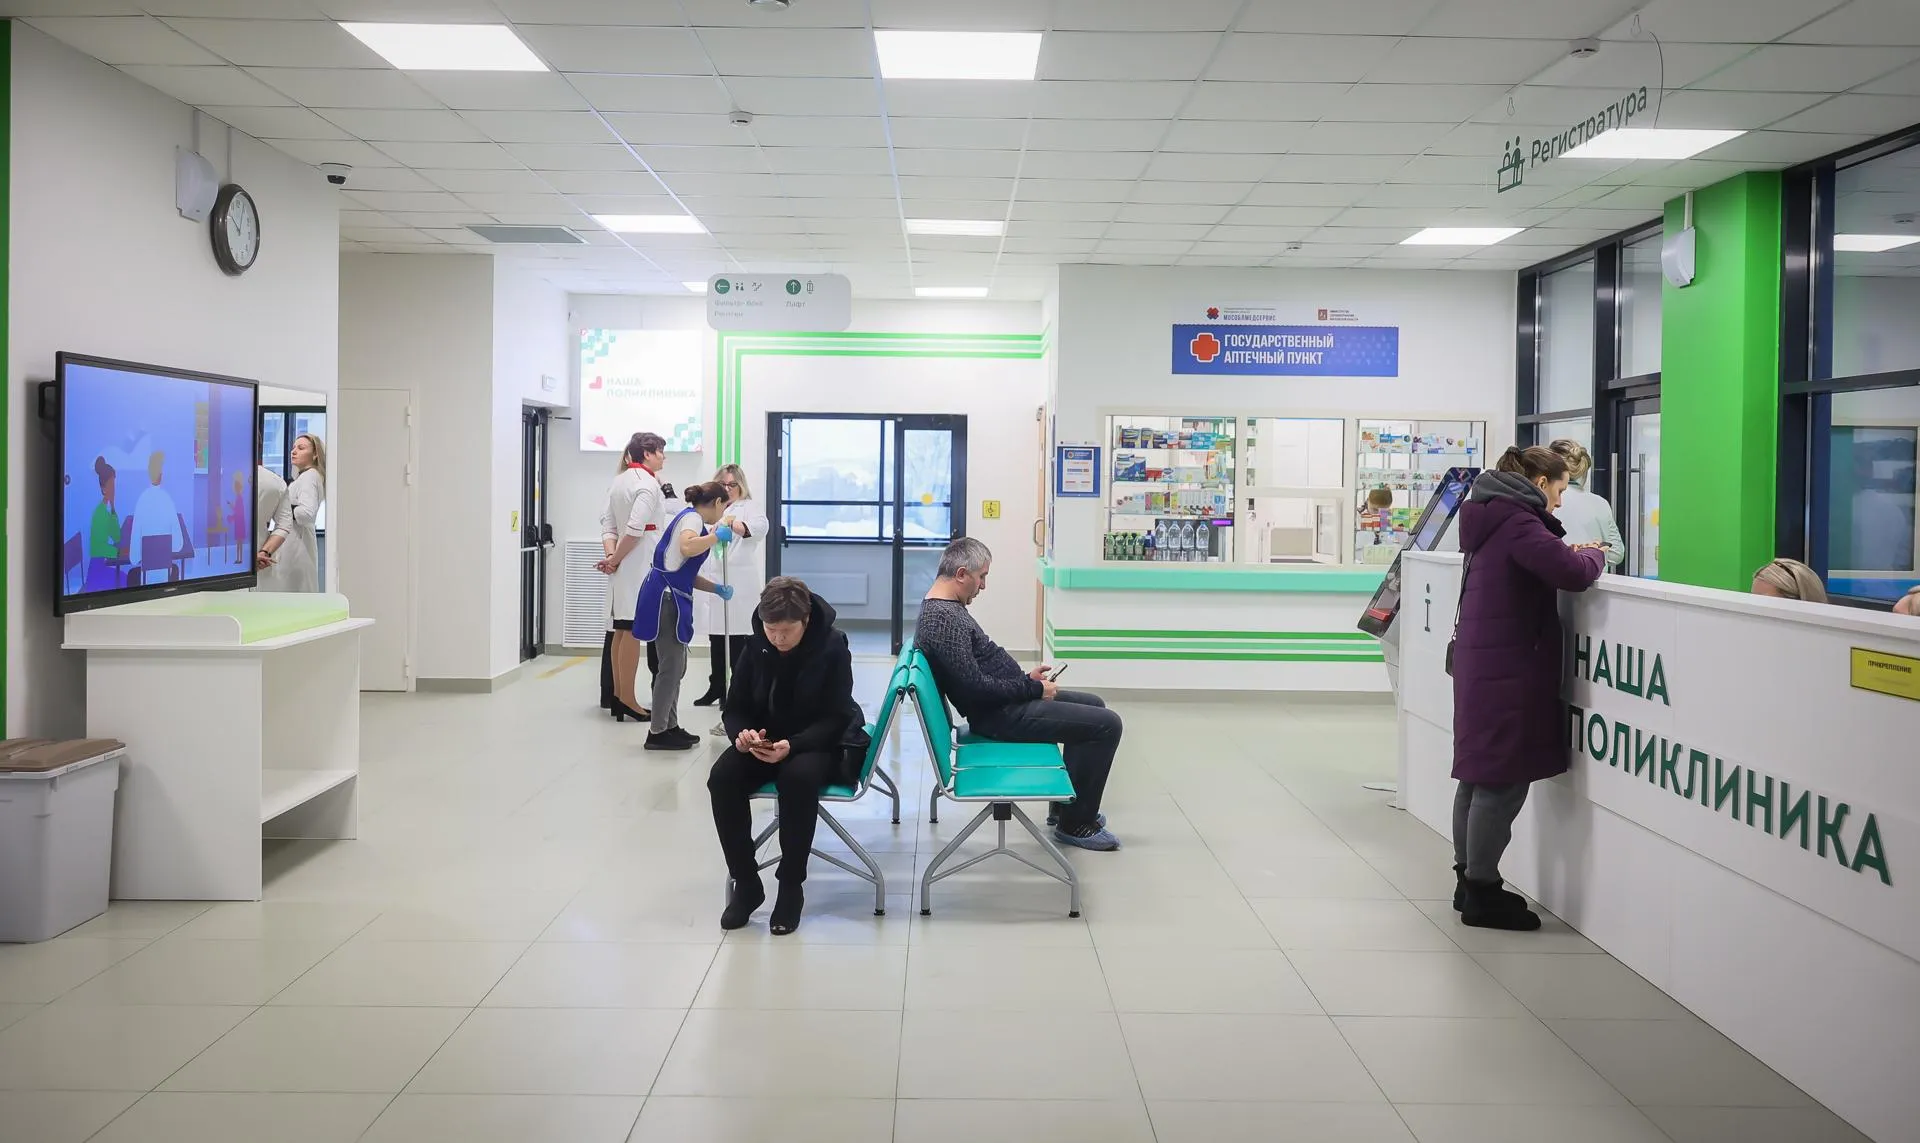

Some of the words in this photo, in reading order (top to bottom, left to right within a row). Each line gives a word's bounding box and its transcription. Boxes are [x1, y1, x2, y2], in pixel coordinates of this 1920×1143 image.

[1531, 86, 1647, 168] Регистратура
[1223, 333, 1334, 349] ГОСУДАРСТВЕННЫЙ
[1223, 349, 1284, 365] АПТЕЧНЫЙ
[1286, 351, 1324, 365] ПУНКТ
[606, 377, 641, 386] НАША
[1574, 633, 1670, 707] НАША
[1568, 704, 1893, 887] ПОЛИКЛИНИКА
